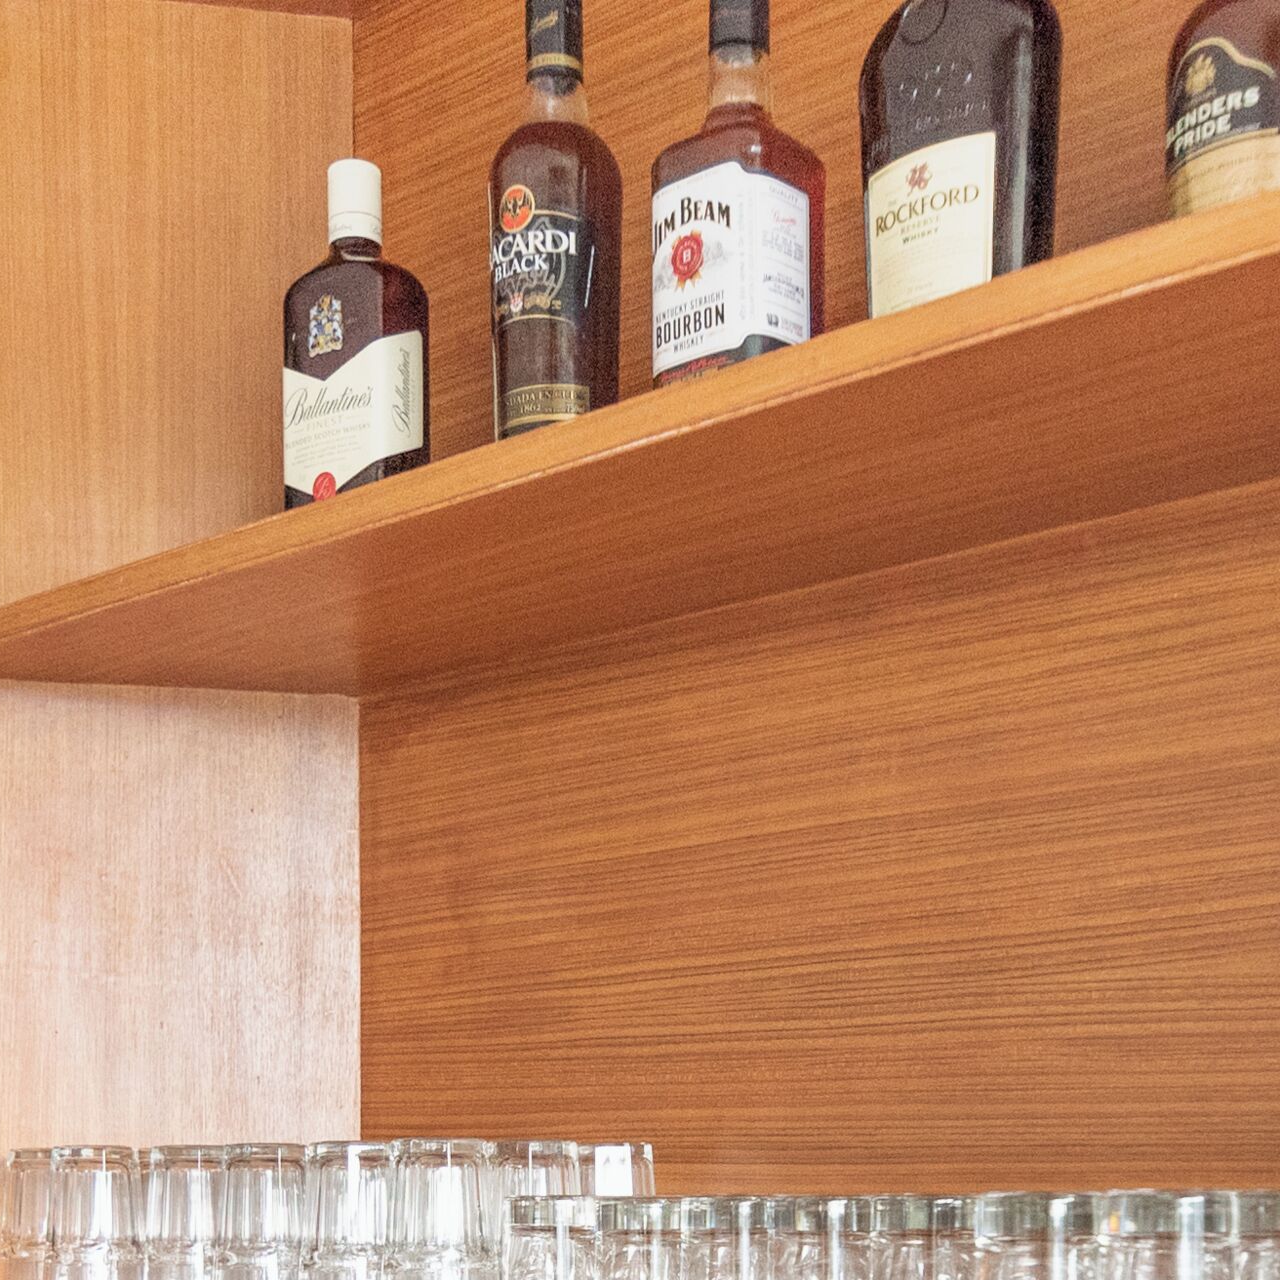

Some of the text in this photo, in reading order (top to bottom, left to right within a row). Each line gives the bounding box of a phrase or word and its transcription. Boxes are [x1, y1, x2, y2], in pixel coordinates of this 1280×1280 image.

[1174, 113, 1231, 157] PRIDE
[652, 210, 676, 263] JIM
[680, 197, 731, 229] BEAM
[875, 184, 979, 238] ROCKFORD
[492, 229, 577, 266] ACARDI
[495, 254, 547, 284] BLACK
[691, 289, 724, 310] STRAIGHT
[656, 303, 725, 349] BOURBON
[673, 335, 703, 353] WHISKEY
[283, 386, 374, 430] Ballantine's
[306, 415, 343, 432] FINEST
